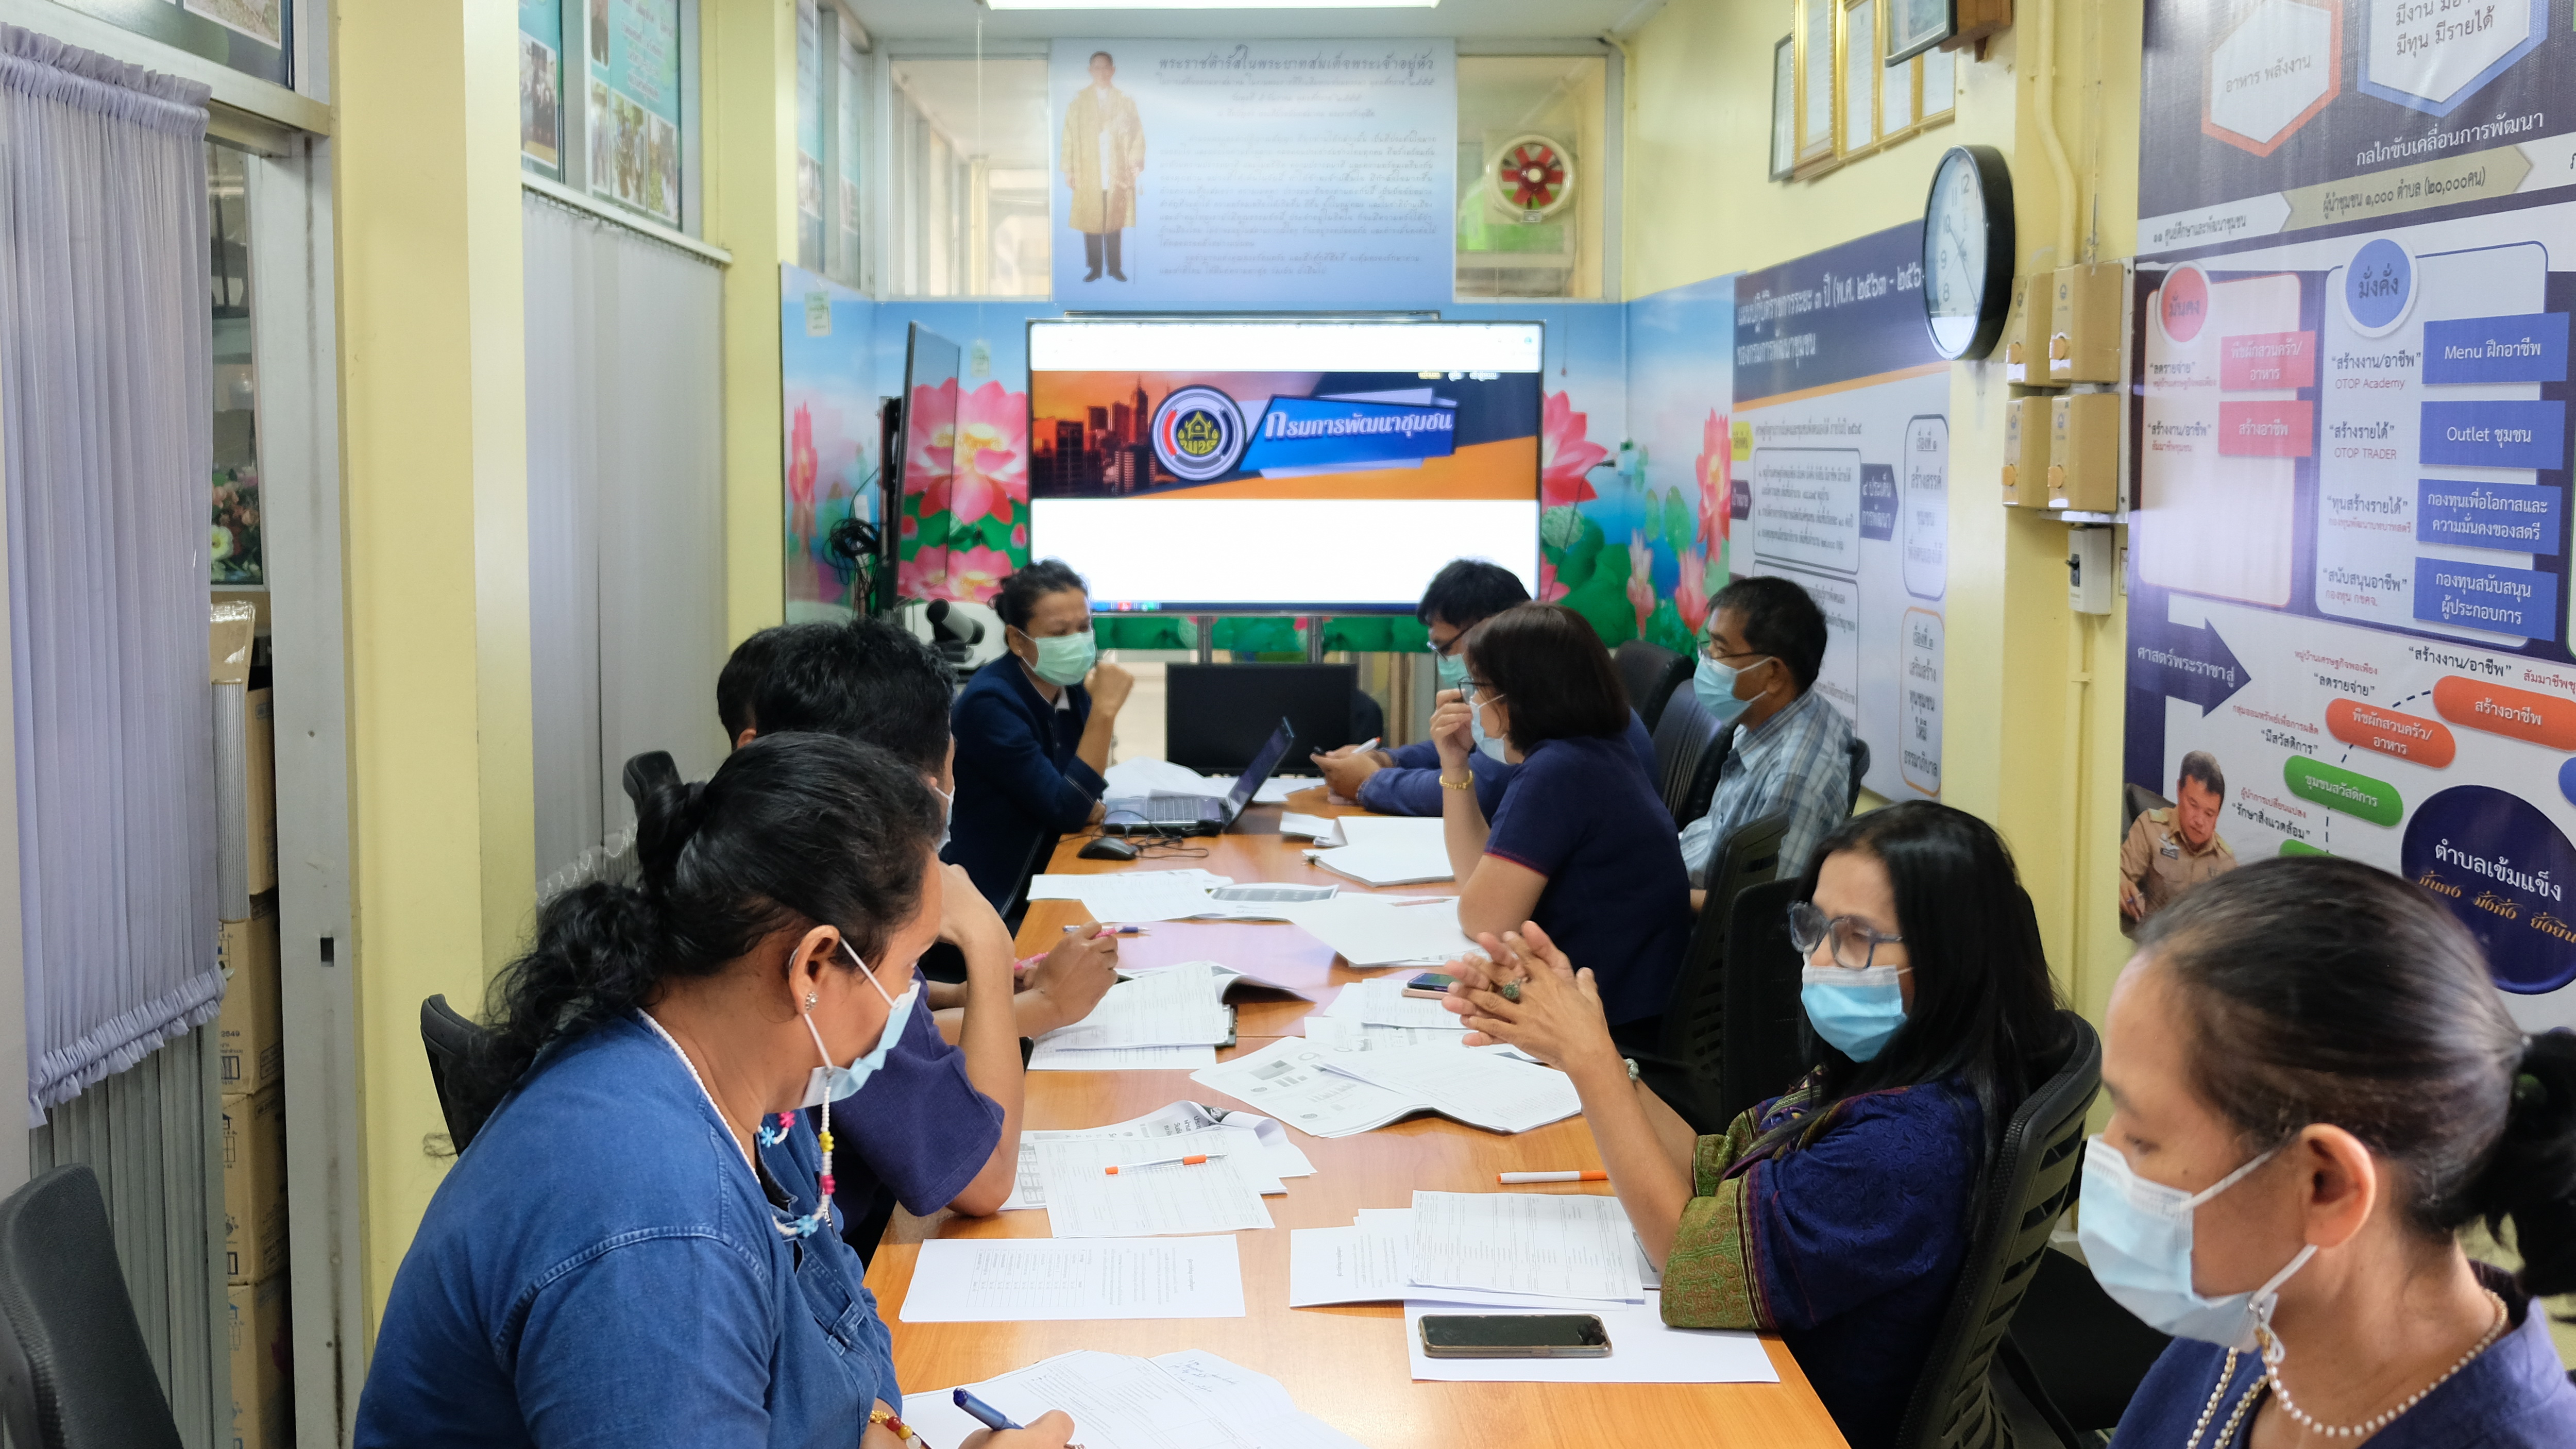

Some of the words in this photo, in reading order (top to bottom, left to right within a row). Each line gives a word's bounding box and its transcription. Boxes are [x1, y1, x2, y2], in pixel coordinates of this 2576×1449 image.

[2396, 1, 2433, 26] มีงาน
[2396, 32, 2428, 57] มีทุน
[2435, 5, 2494, 44] มีรายได้
[2226, 69, 2260, 93] อาหาร
[2264, 54, 2312, 81] พลังงาน
[2356, 110, 2544, 167] กลไกขับเคลื่อนการพัฒนา
[2323, 191, 2363, 220] ผู้นำชุมชน
[2397, 176, 2421, 199] ตำบล
[1940, 249, 1947, 270] 9
[1896, 262, 1923, 291] ๒๕๖
[2358, 262, 2399, 299] มั่งคั่ง
[1942, 282, 1950, 303] 8
[2331, 348, 2421, 370] “สร้างงาน/อาชีพ”
[2444, 345, 2482, 360] Menu
[2486, 339, 2541, 360] ฝึกอาชีพ
[2249, 365, 2280, 381] อาหาร
[2335, 377, 2360, 390] OTOP
[2363, 376, 2405, 391] Academy
[1264, 410, 1453, 440] กรมการพัฒนาชุมชน
[2238, 418, 2289, 438] สร้างอาชีพ
[2328, 420, 2395, 441] “สร้างรายได้”
[2446, 426, 2490, 443] Outlet
[2494, 428, 2532, 449] ชุมชน
[2333, 447, 2359, 459] OTOP
[2362, 447, 2397, 461] TRADER
[2327, 494, 2408, 515] “ทุนสร้างรายได้”
[2427, 490, 2548, 515] กองทุนเพื่อโอกาสและ
[2432, 515, 2541, 541] ความมั่นคงของสตรี
[2323, 566, 2407, 592] “สนับสนุนอาชีพ”
[2435, 572, 2531, 600] กองทุนสนับสนุน
[2441, 597, 2522, 627] ผู้ประกอบการ
[2137, 646, 2235, 688] ศาสตร์พระราชาสู่
[2409, 646, 2512, 677] “สร้างงาน/อาชีพ”
[2523, 668, 2576, 695] สัมมาชีพชุ
[2313, 672, 2376, 696] “ลดรายจ่าย”
[2352, 706, 2432, 743] พืชผักสวนครัว/
[2475, 696, 2543, 727] สร้างอาชีพ
[2261, 728, 2318, 755] “มีสวัสดิการ”
[2372, 734, 2408, 756] อาหาร
[2304, 774, 2378, 807] ชุมชนสวัสดิการ
[2231, 803, 2311, 840] “รักษาสิ่งแวดล้อม”
[2435, 838, 2562, 902] ตำบลเข้มแข็ง
